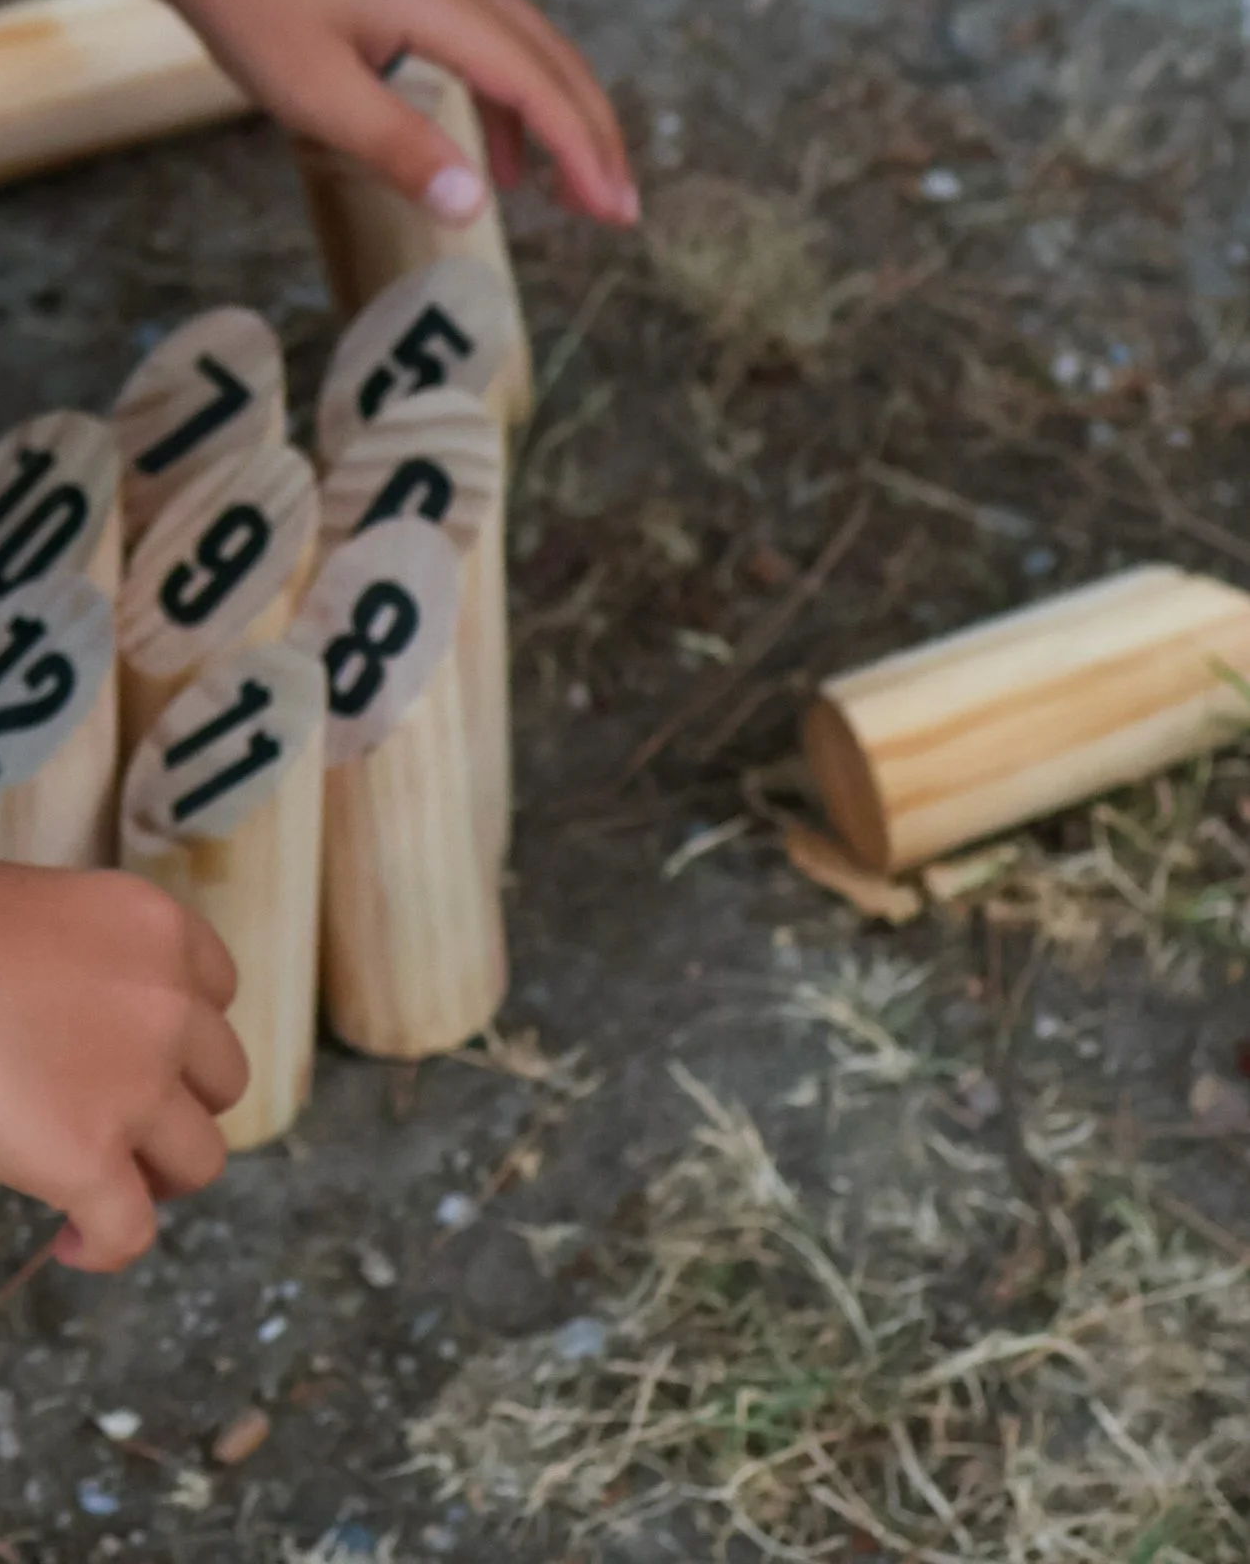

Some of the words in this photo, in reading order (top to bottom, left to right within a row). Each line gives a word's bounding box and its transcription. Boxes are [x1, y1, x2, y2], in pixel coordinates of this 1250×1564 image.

[135, 354, 253, 476] 7
[357, 304, 474, 422] 5
[158, 504, 272, 628] 9
[322, 580, 419, 719] 8
[163, 679, 281, 824] 11
